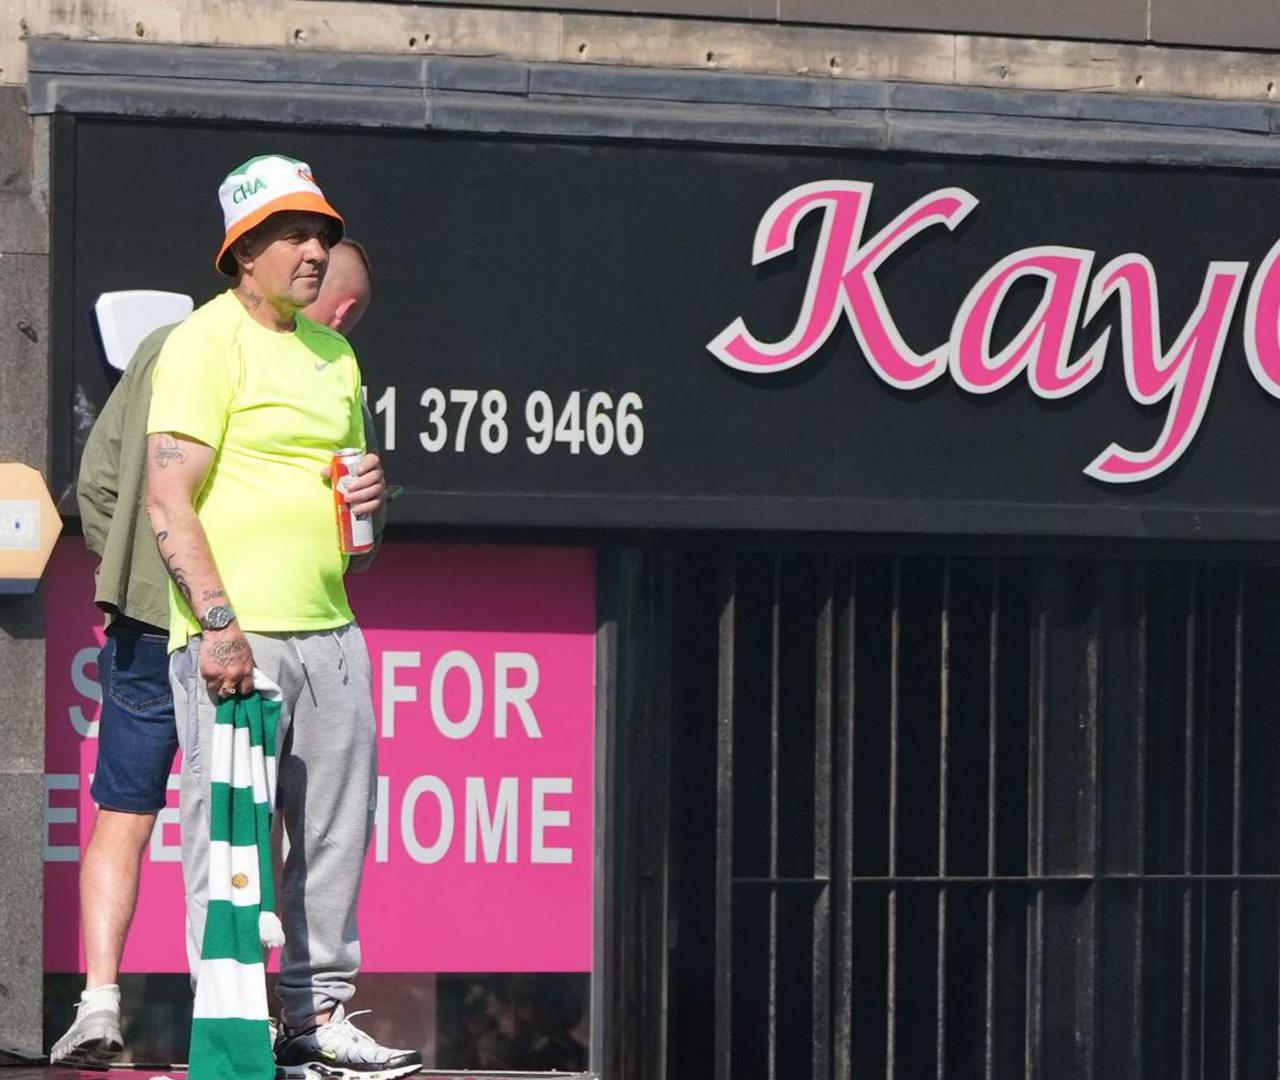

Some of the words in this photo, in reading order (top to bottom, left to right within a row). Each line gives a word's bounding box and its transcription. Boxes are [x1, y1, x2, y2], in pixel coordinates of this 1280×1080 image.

[705, 180, 1280, 483] Kay
[418, 387, 509, 454] 378
[525, 390, 644, 456] 9466
[380, 650, 544, 739] FOR
